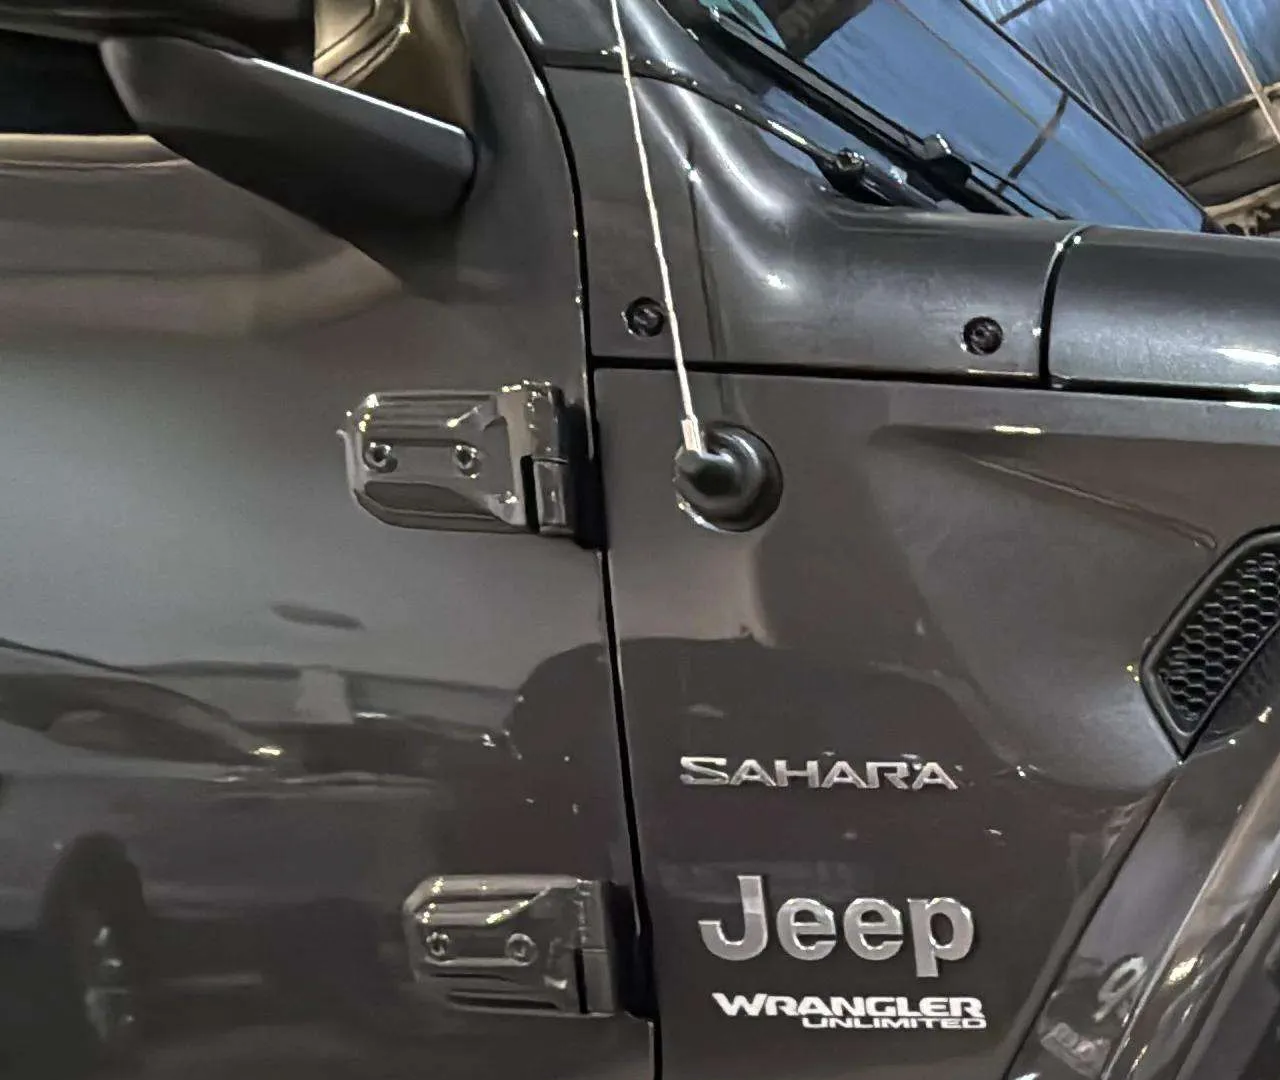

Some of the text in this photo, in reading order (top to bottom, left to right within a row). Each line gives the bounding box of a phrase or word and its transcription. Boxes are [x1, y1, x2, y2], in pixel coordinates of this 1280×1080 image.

[680, 756, 958, 790] SAHARA
[698, 875, 974, 978] Jeep
[712, 993, 986, 1018] WRANGLER
[802, 1017, 987, 1029] UNLIMITED
